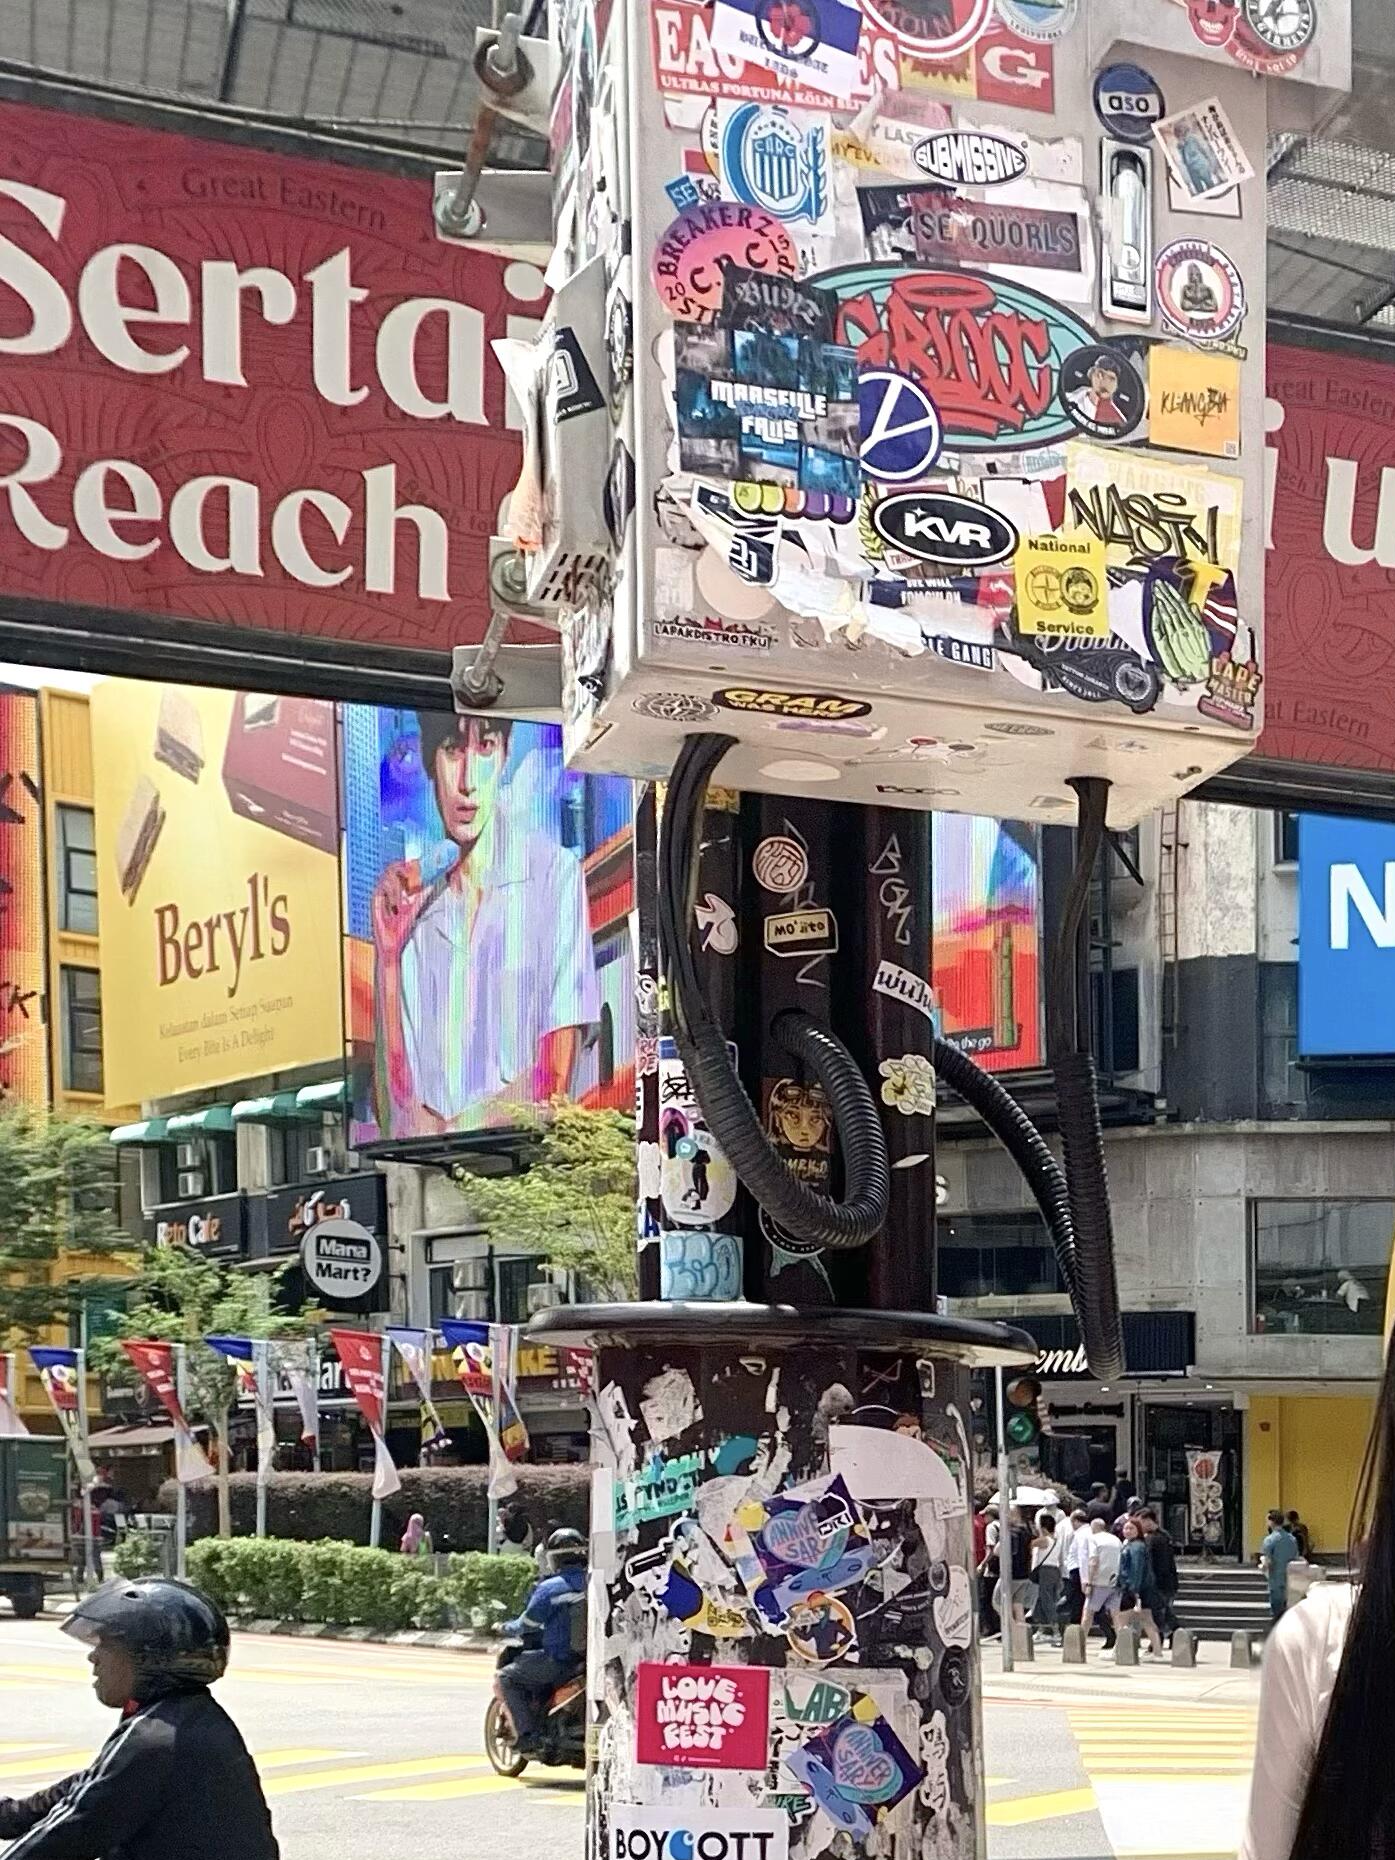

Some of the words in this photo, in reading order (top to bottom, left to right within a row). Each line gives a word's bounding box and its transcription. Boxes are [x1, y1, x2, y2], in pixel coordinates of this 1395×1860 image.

[181, 168, 267, 201] Great
[280, 177, 387, 231] Eastern
[0, 412, 453, 602] Reach
[1028, 538, 1092, 555] National
[1036, 620, 1095, 635] Service
[951, 641, 992, 668] GANG
[724, 690, 865, 714] GRAM
[1293, 698, 1370, 738] Eastern
[154, 872, 291, 998] Beryl's
[319, 1238, 368, 1259] Mana
[315, 1262, 372, 1283] Mart?
[662, 1674, 739, 1703] LOVE
[657, 1700, 746, 1726] MUSIC
[662, 1723, 732, 1751] FEST
